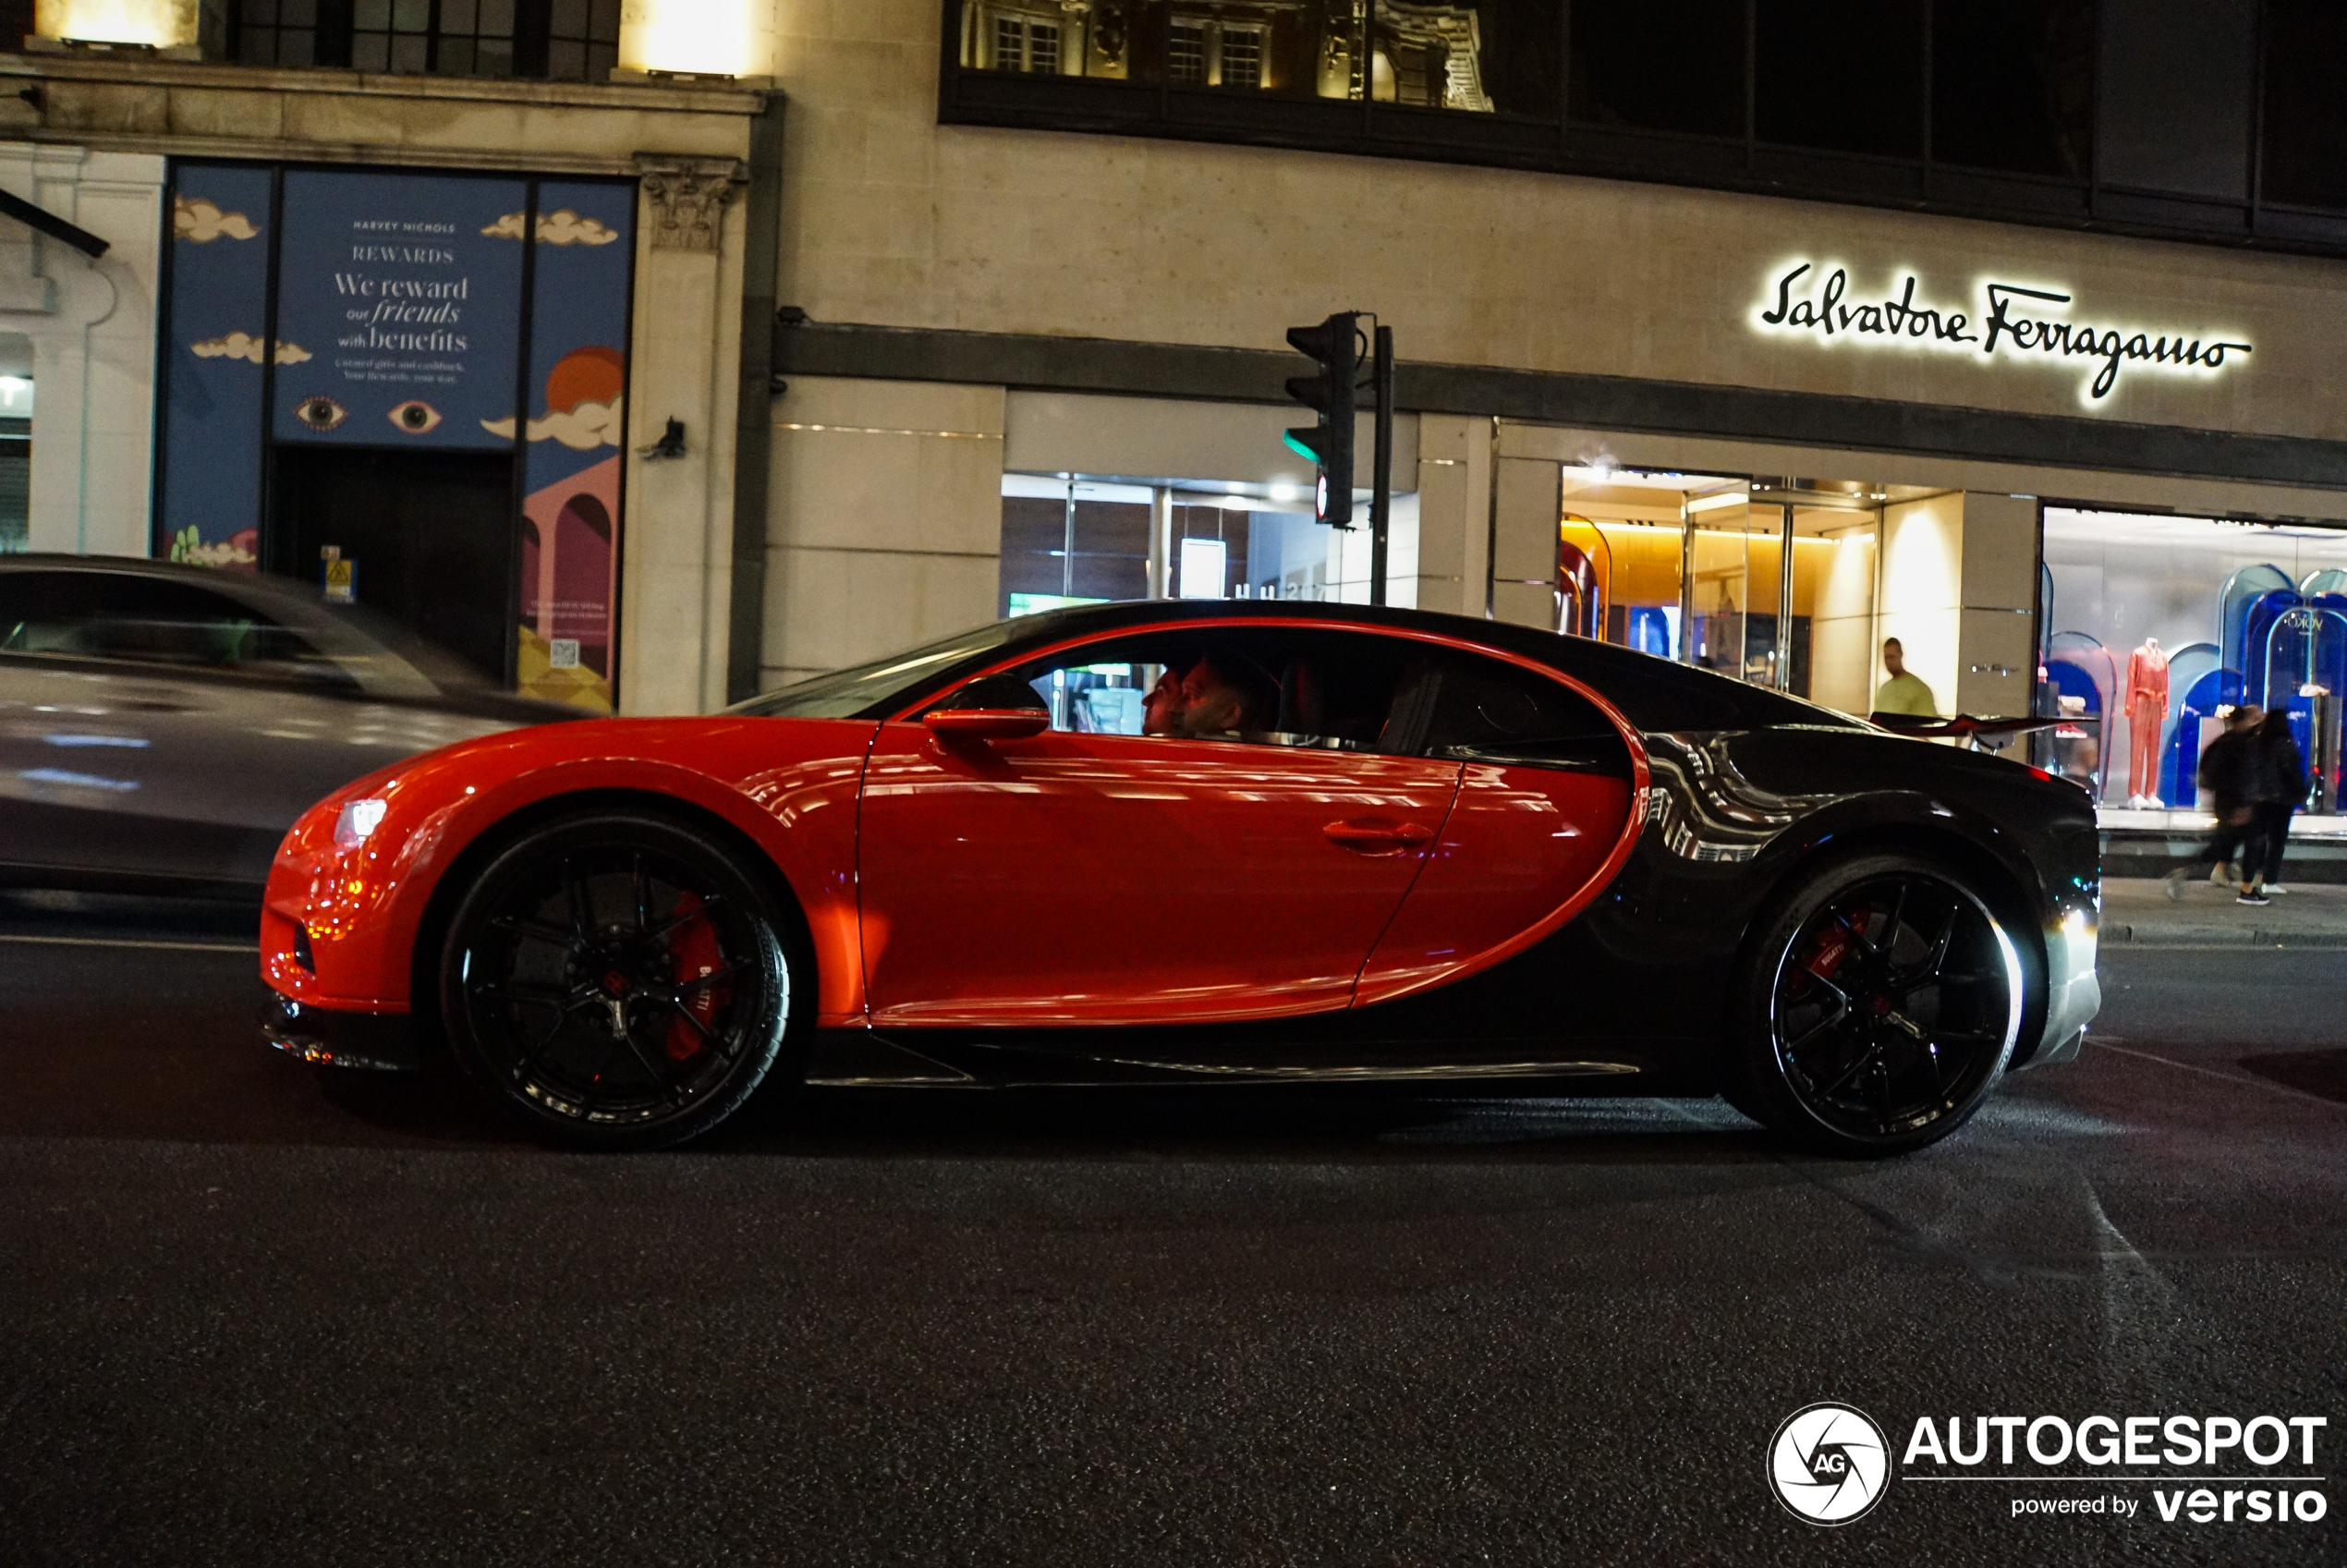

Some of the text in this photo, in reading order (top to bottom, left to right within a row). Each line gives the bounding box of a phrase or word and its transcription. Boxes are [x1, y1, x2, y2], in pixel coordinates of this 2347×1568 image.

[353, 221, 456, 234] HARVEY NICHOLS
[353, 246, 454, 263] REWARDS
[334, 273, 468, 299] We reward
[347, 298, 461, 328] our friends
[337, 326, 468, 352] with benefits
[1762, 263, 2252, 398] Salvatore Ferragamo
[1821, 943, 1844, 966] BUGATTI
